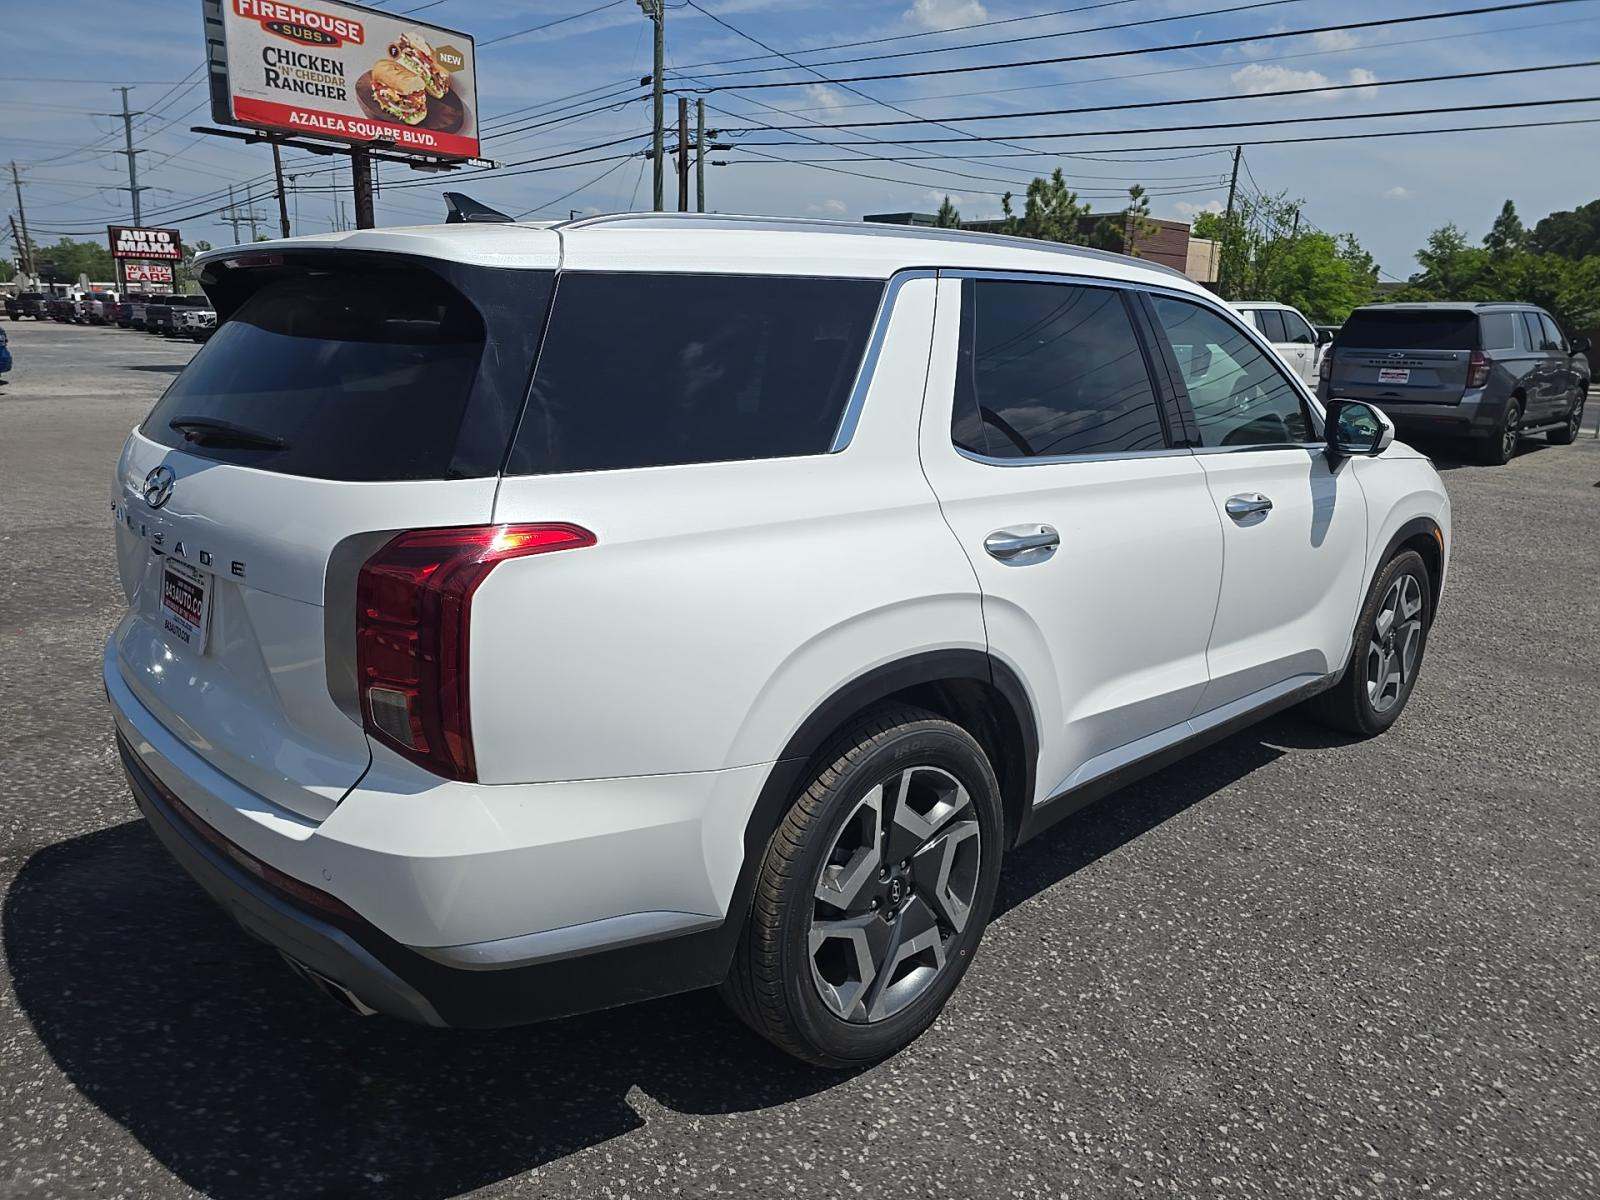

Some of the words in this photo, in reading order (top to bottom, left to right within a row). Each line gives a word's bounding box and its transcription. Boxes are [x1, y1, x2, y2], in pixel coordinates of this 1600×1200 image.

[239, 0, 361, 43] FIREHOUSE
[282, 24, 322, 42] SUBS
[262, 46, 345, 77] CHICKEN
[439, 51, 462, 66] NEW
[264, 67, 348, 101] RANCHER
[295, 69, 346, 87] CHEDDAR
[289, 111, 346, 132] AZALEA
[348, 122, 401, 141] SQUARE
[402, 130, 438, 147] BLVD.
[121, 230, 170, 242] AUTO
[117, 240, 177, 253] MAXX
[128, 272, 172, 282] CARS
